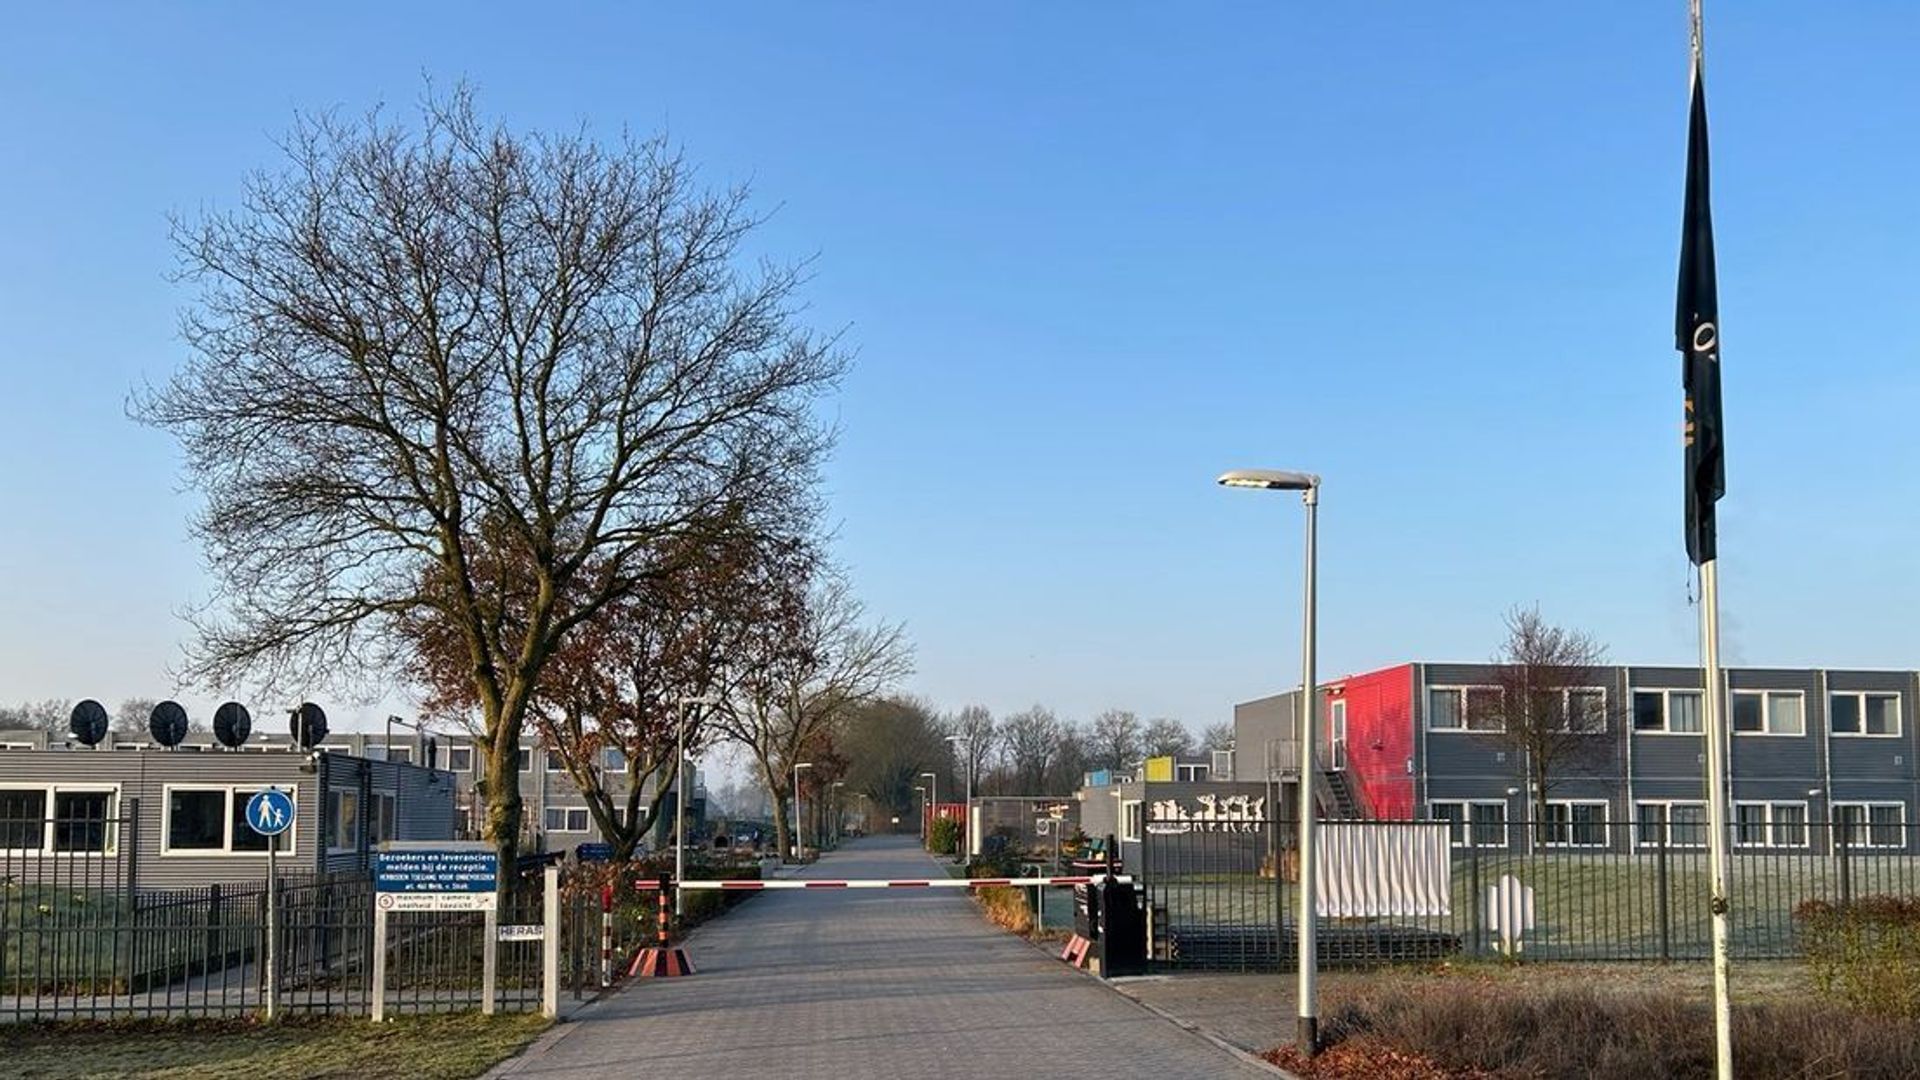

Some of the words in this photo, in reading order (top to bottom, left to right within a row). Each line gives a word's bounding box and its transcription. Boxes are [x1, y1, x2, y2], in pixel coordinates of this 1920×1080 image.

[379, 853, 425, 862] Bezoekers
[427, 854, 439, 862] en
[441, 853, 496, 862] leveranciers
[386, 863, 420, 871] melden
[421, 863, 434, 872] bij
[435, 863, 447, 871] de
[501, 926, 543, 935] HERAS
